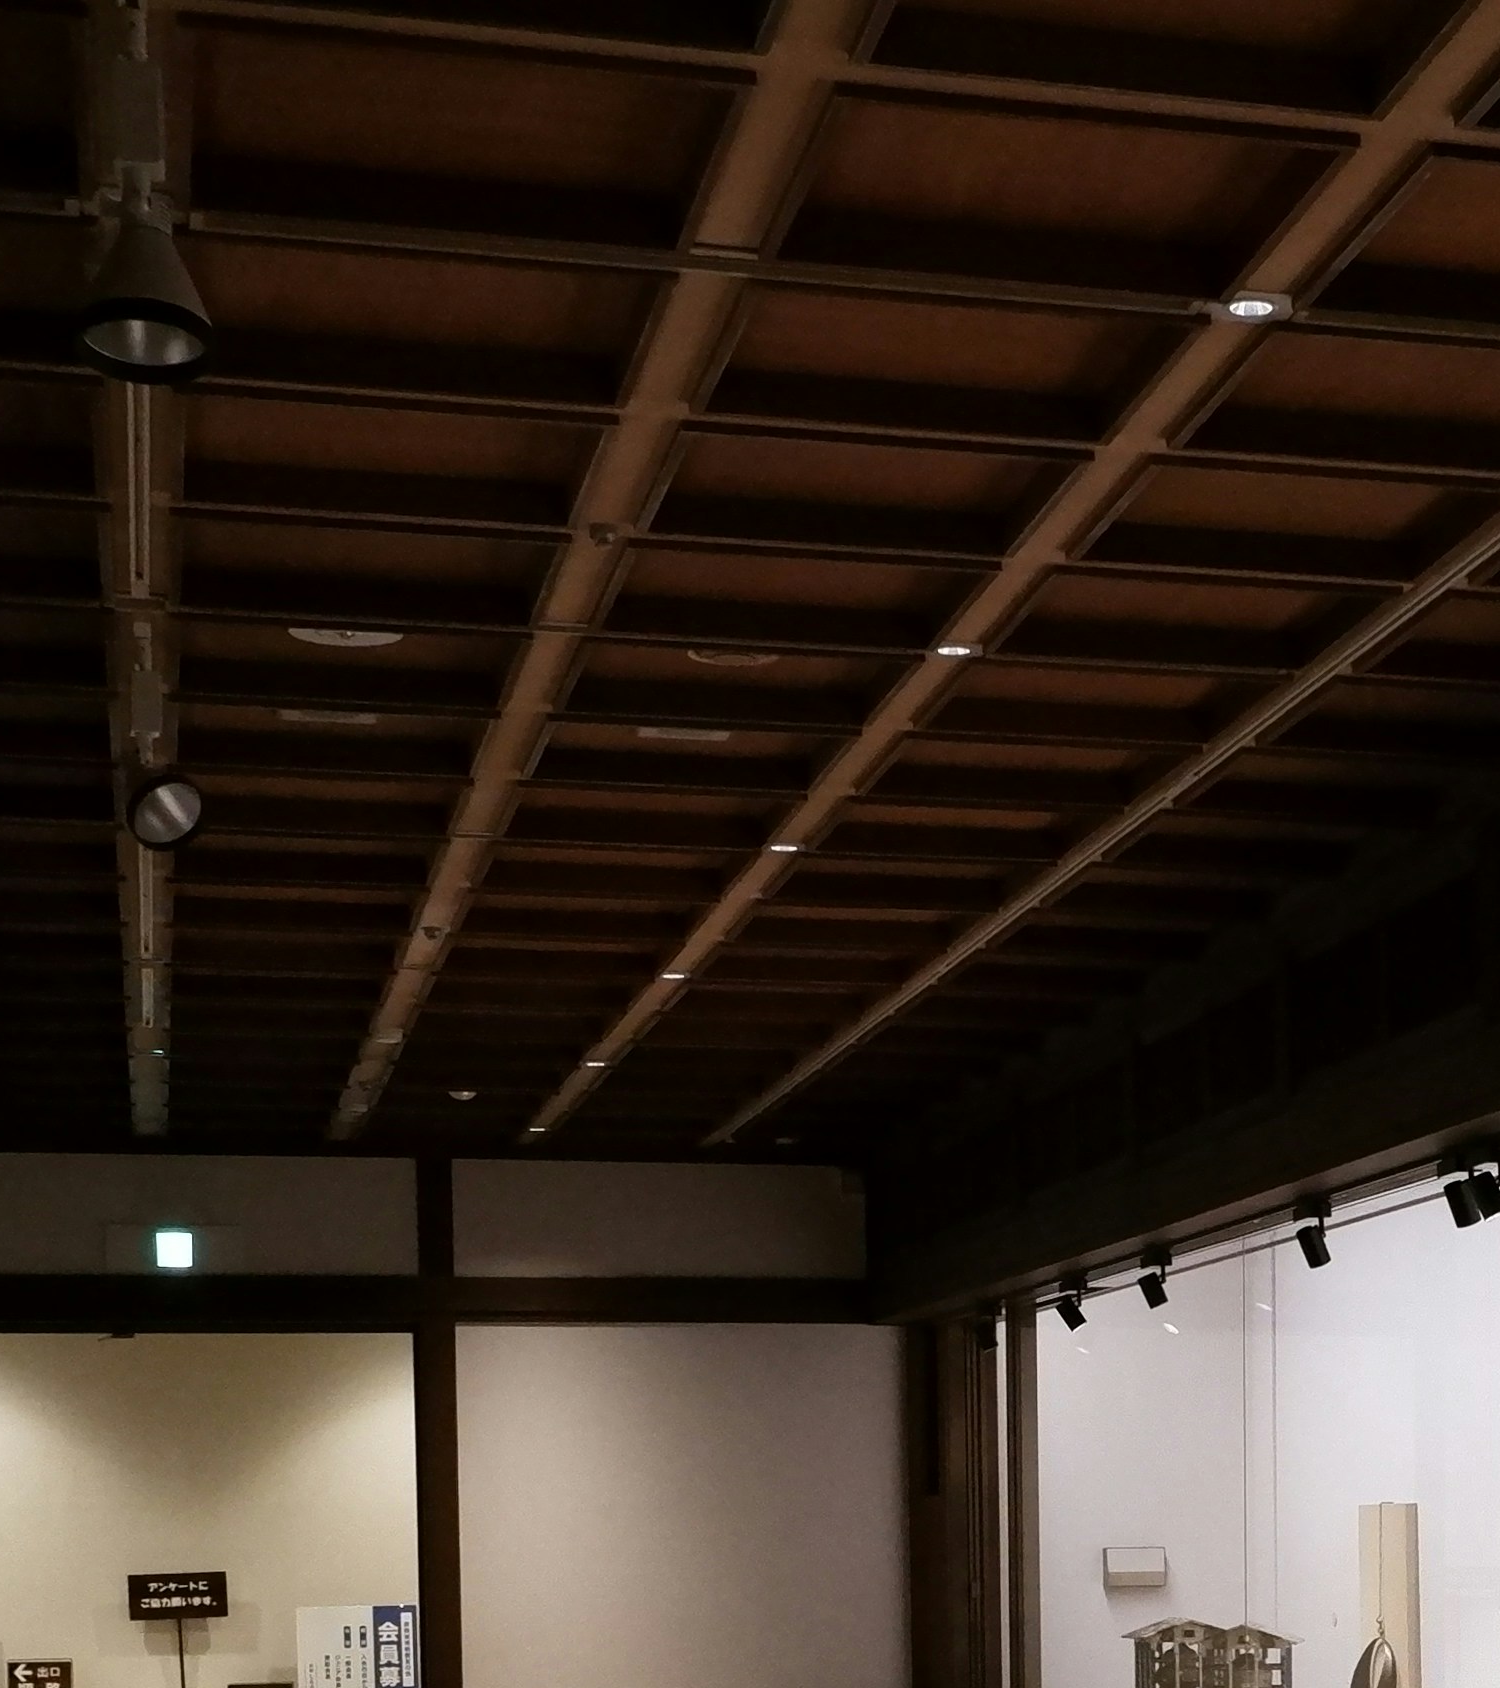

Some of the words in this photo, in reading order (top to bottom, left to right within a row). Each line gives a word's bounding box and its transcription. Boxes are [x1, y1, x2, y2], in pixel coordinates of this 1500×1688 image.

[147, 1581, 209, 1592] アンケートに
[36, 1666, 61, 1679] 出口
